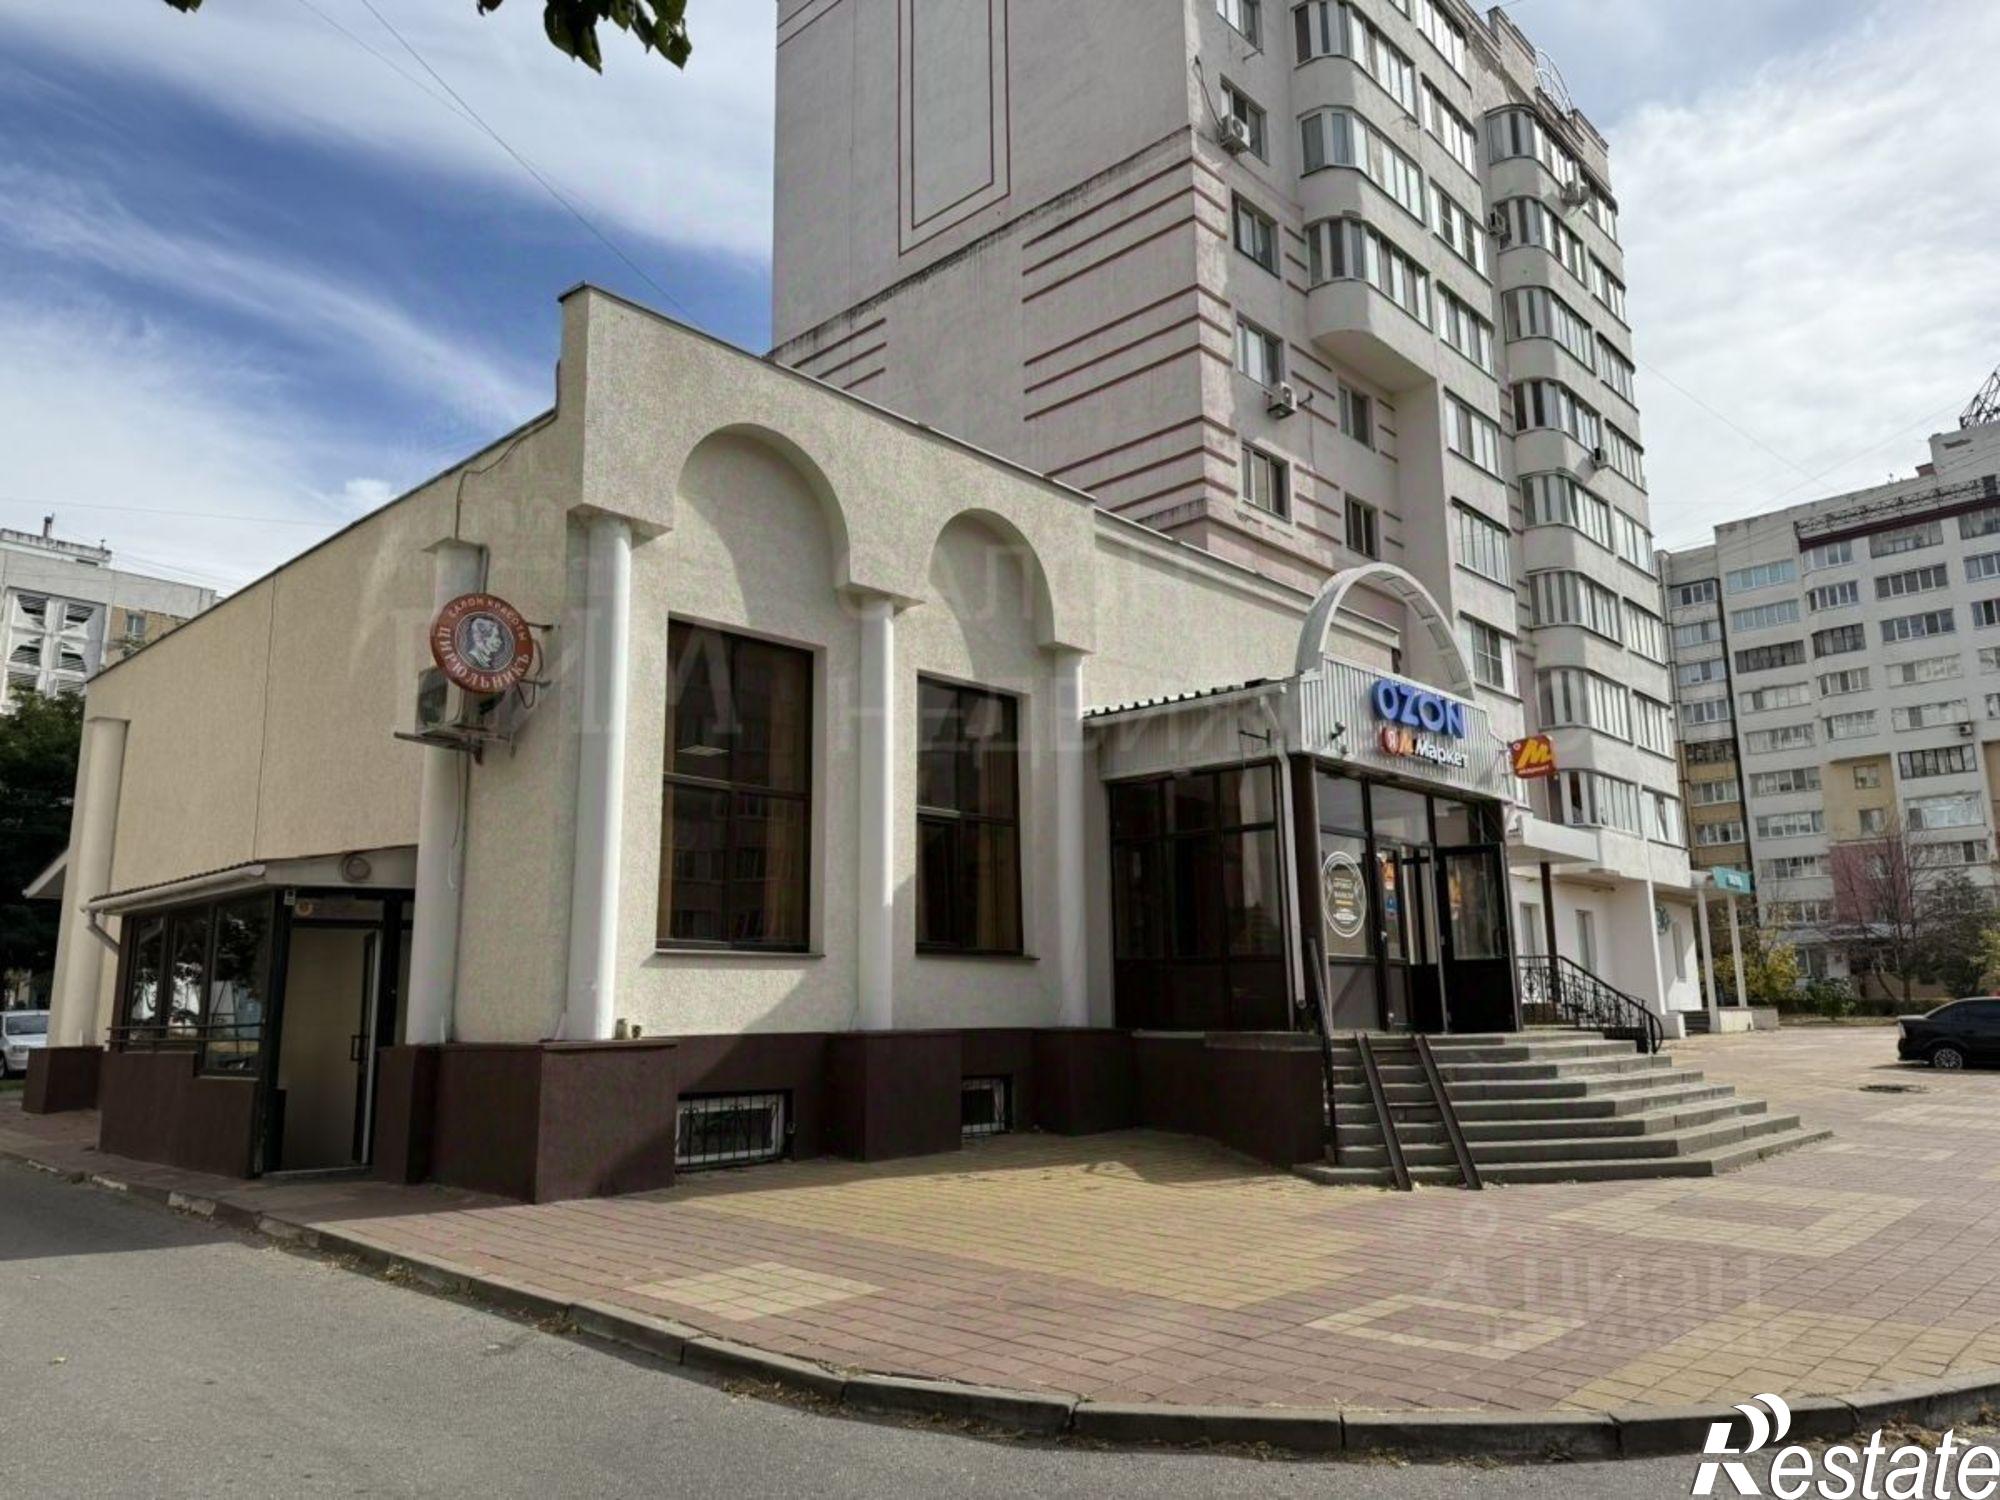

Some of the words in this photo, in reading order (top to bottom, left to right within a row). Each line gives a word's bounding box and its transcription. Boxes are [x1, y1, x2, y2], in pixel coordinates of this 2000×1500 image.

[447, 598, 485, 618] САЛОН
[487, 599, 528, 640] КРАСОТЫ
[1372, 679, 1464, 738] OZON
[1415, 738, 1468, 769] Маркет
